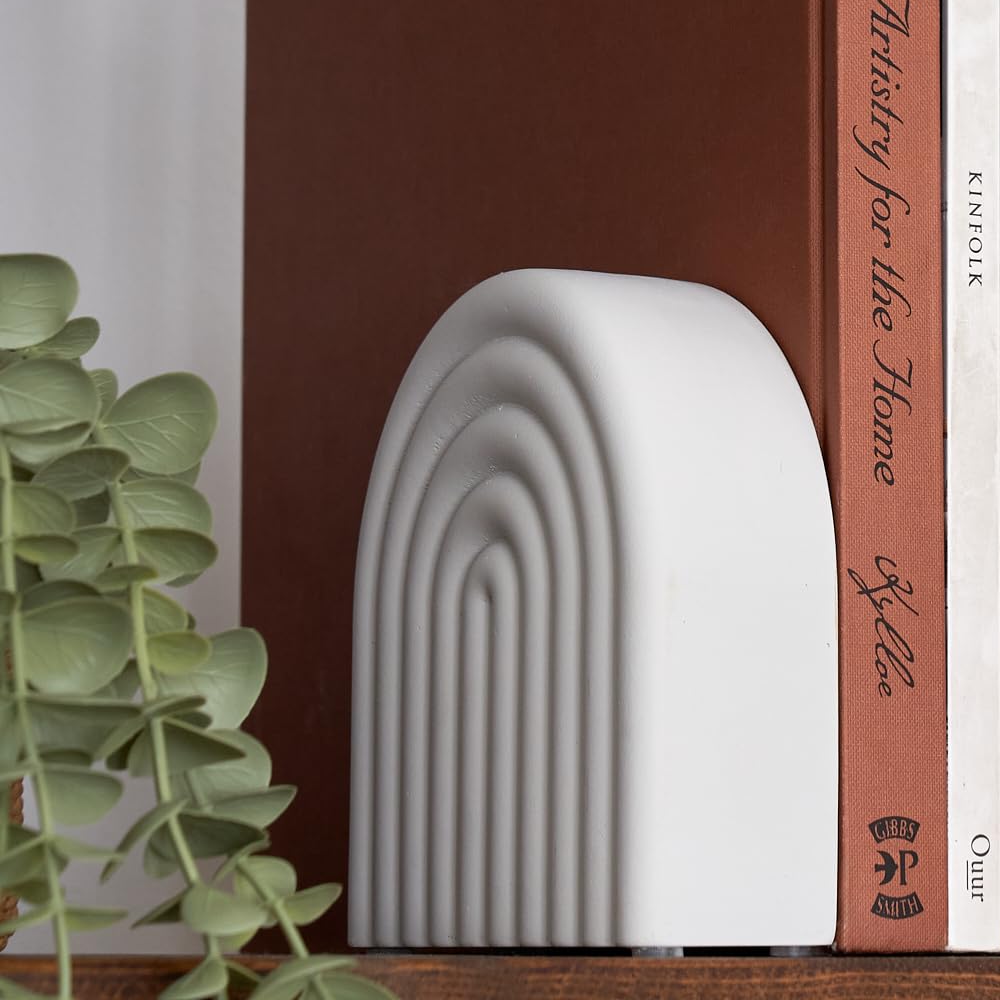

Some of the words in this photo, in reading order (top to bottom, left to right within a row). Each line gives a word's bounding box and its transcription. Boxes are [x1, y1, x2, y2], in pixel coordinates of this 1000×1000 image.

[854, 165, 911, 253] for
[968, 171, 983, 287] KINFOLK
[871, 255, 912, 332] the
[872, 338, 914, 487] Home
[847, 555, 920, 698] Kylloe
[873, 817, 917, 842] GIBBS
[970, 833, 991, 903] Ouur
[874, 893, 920, 919] SMITH
